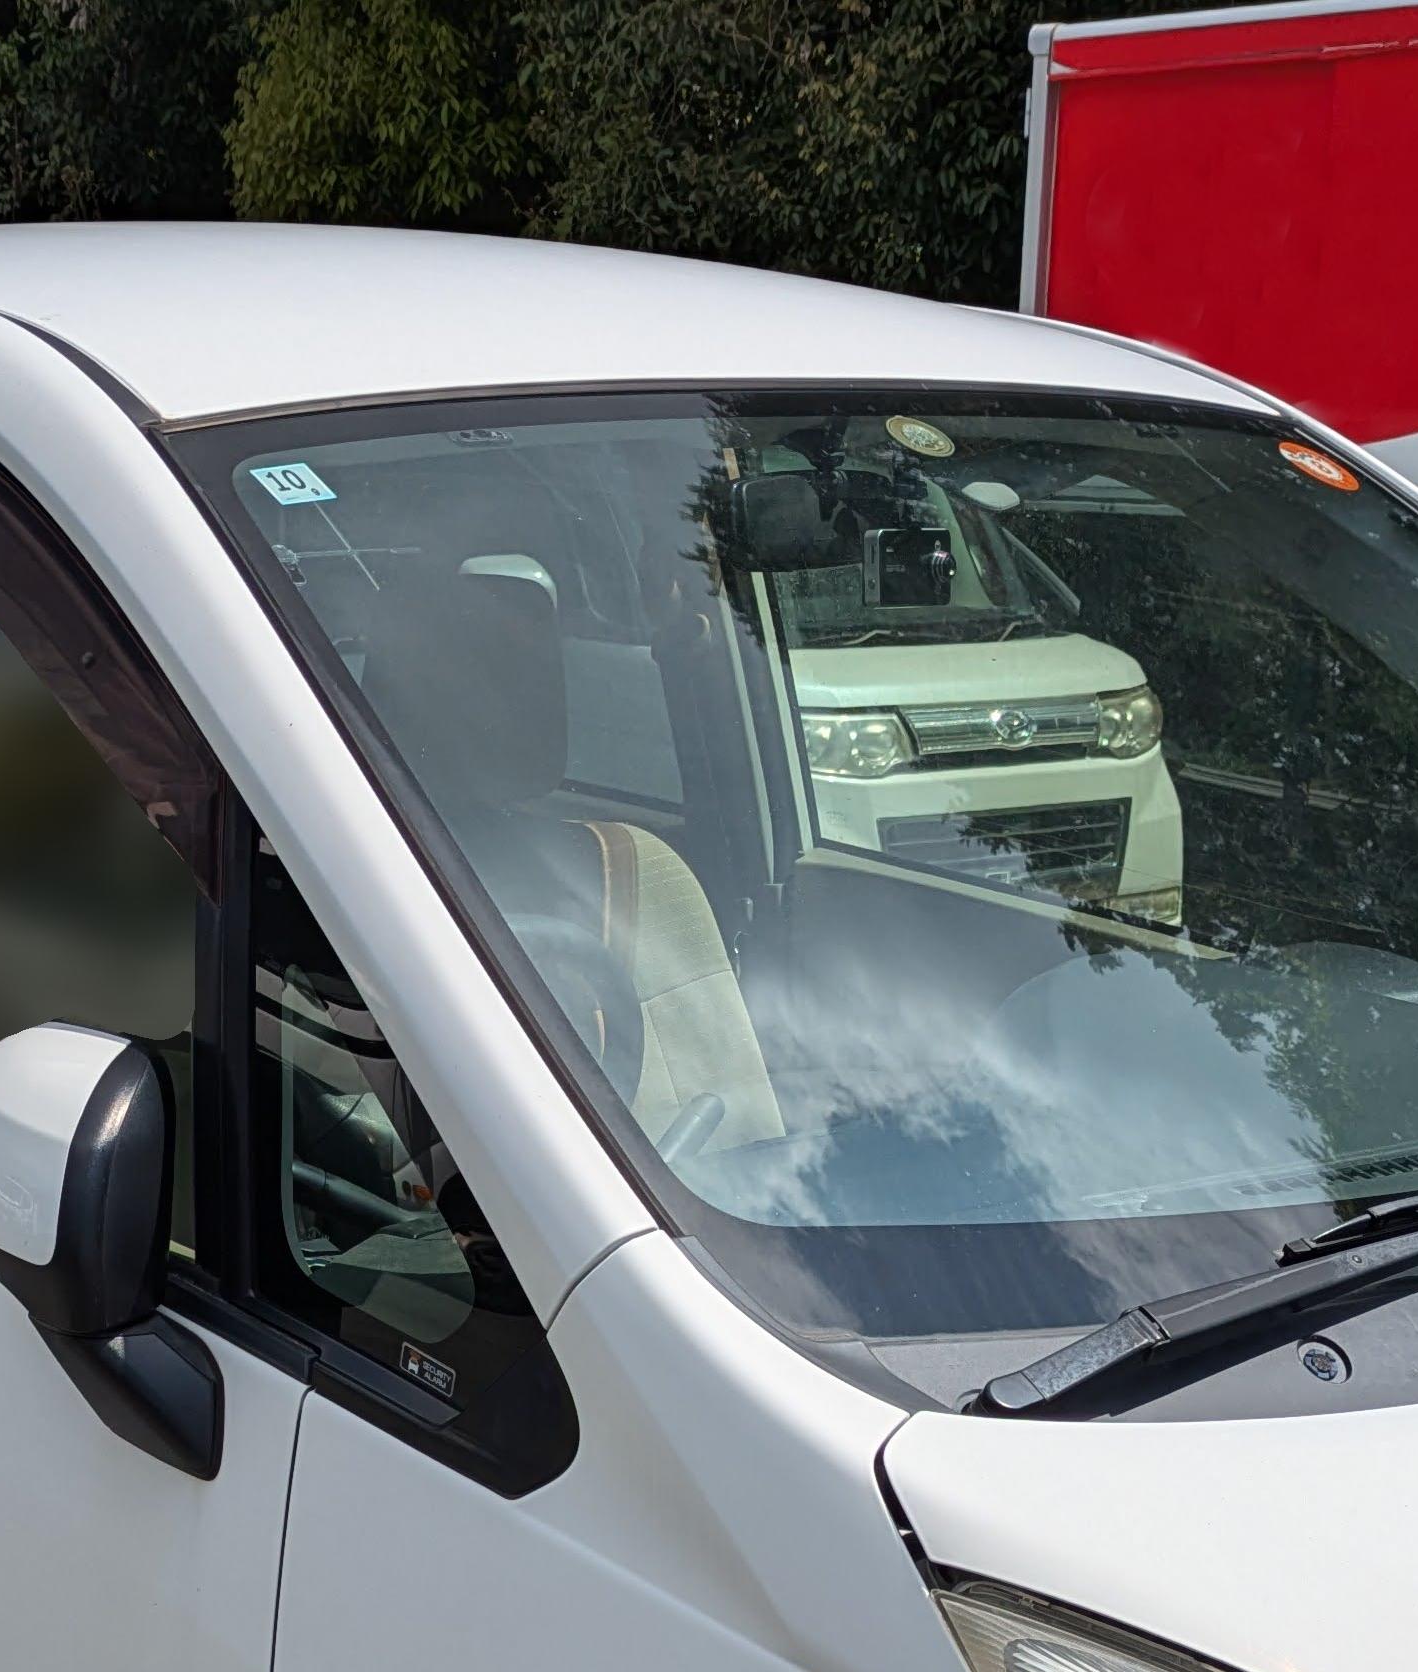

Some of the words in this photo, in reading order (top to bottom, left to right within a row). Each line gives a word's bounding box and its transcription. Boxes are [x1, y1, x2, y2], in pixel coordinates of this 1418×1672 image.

[265, 469, 307, 492] 10
[422, 1360, 452, 1383] SECURITY
[424, 1371, 447, 1390] ALARM
